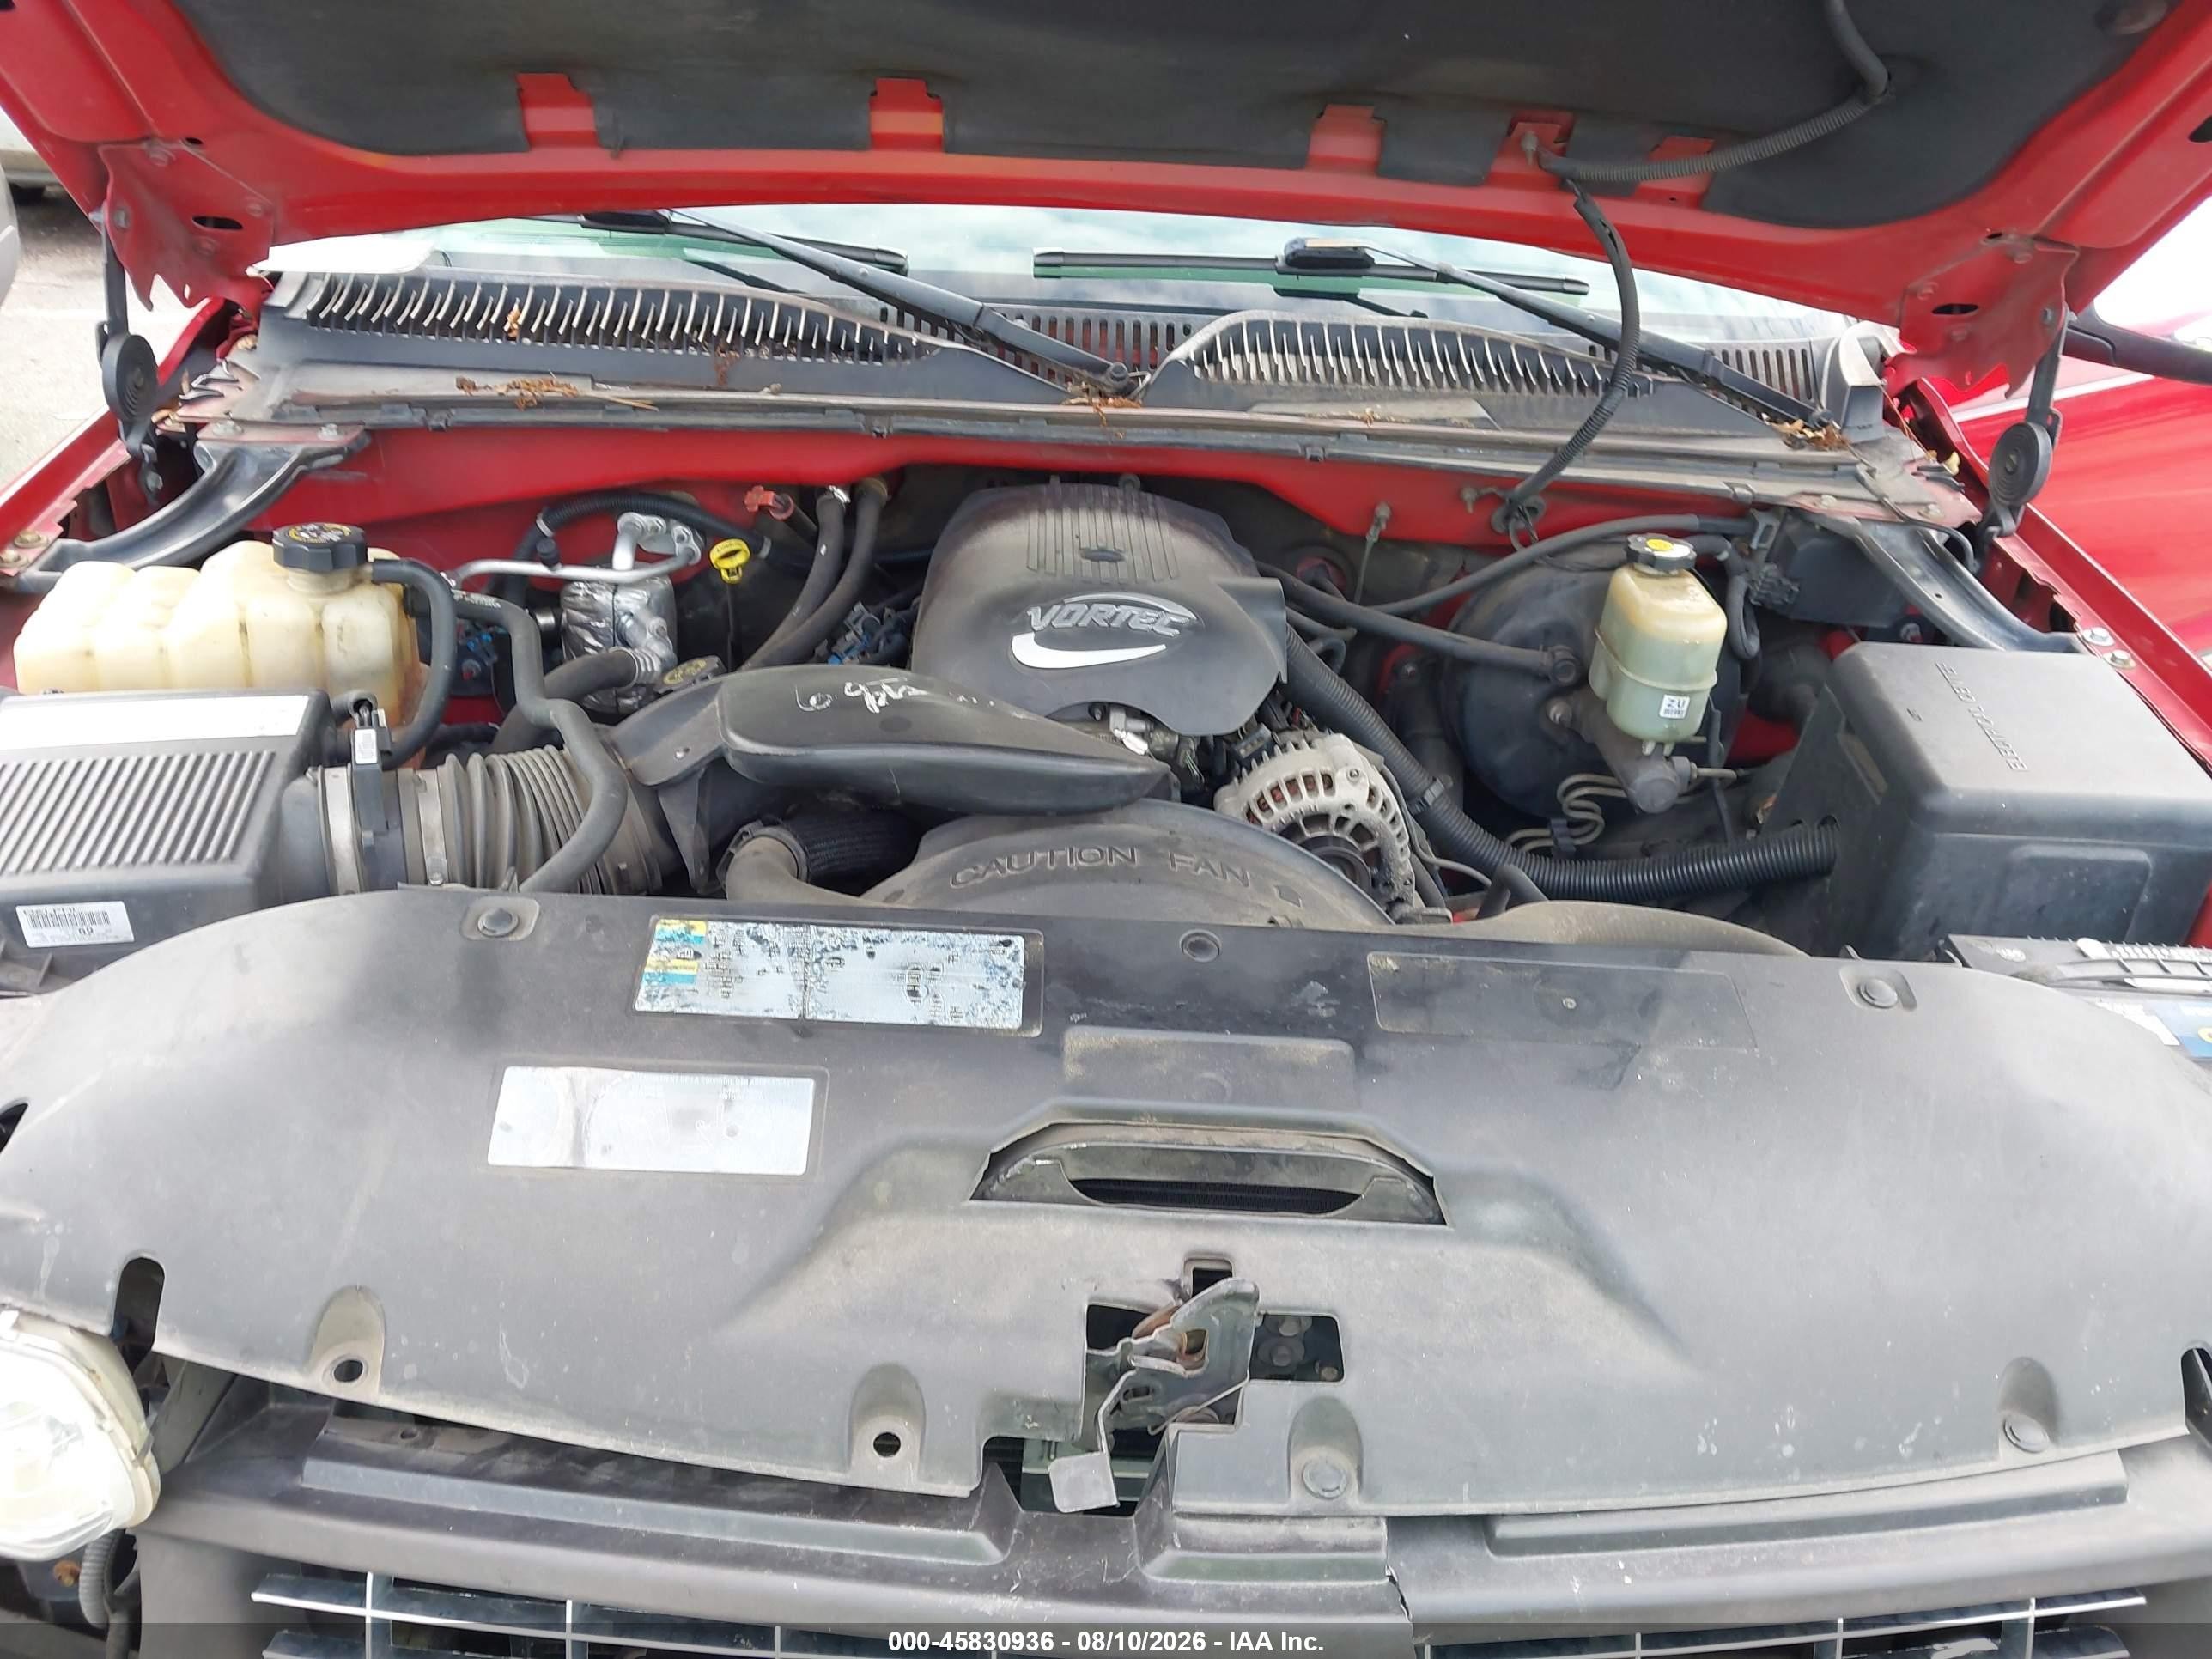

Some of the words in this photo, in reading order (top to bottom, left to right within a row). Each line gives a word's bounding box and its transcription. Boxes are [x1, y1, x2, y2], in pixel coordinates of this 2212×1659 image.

[1027, 603, 1190, 637] VORTEC
[950, 846, 1139, 888] CAUTION
[1169, 852, 1250, 887] FAN
